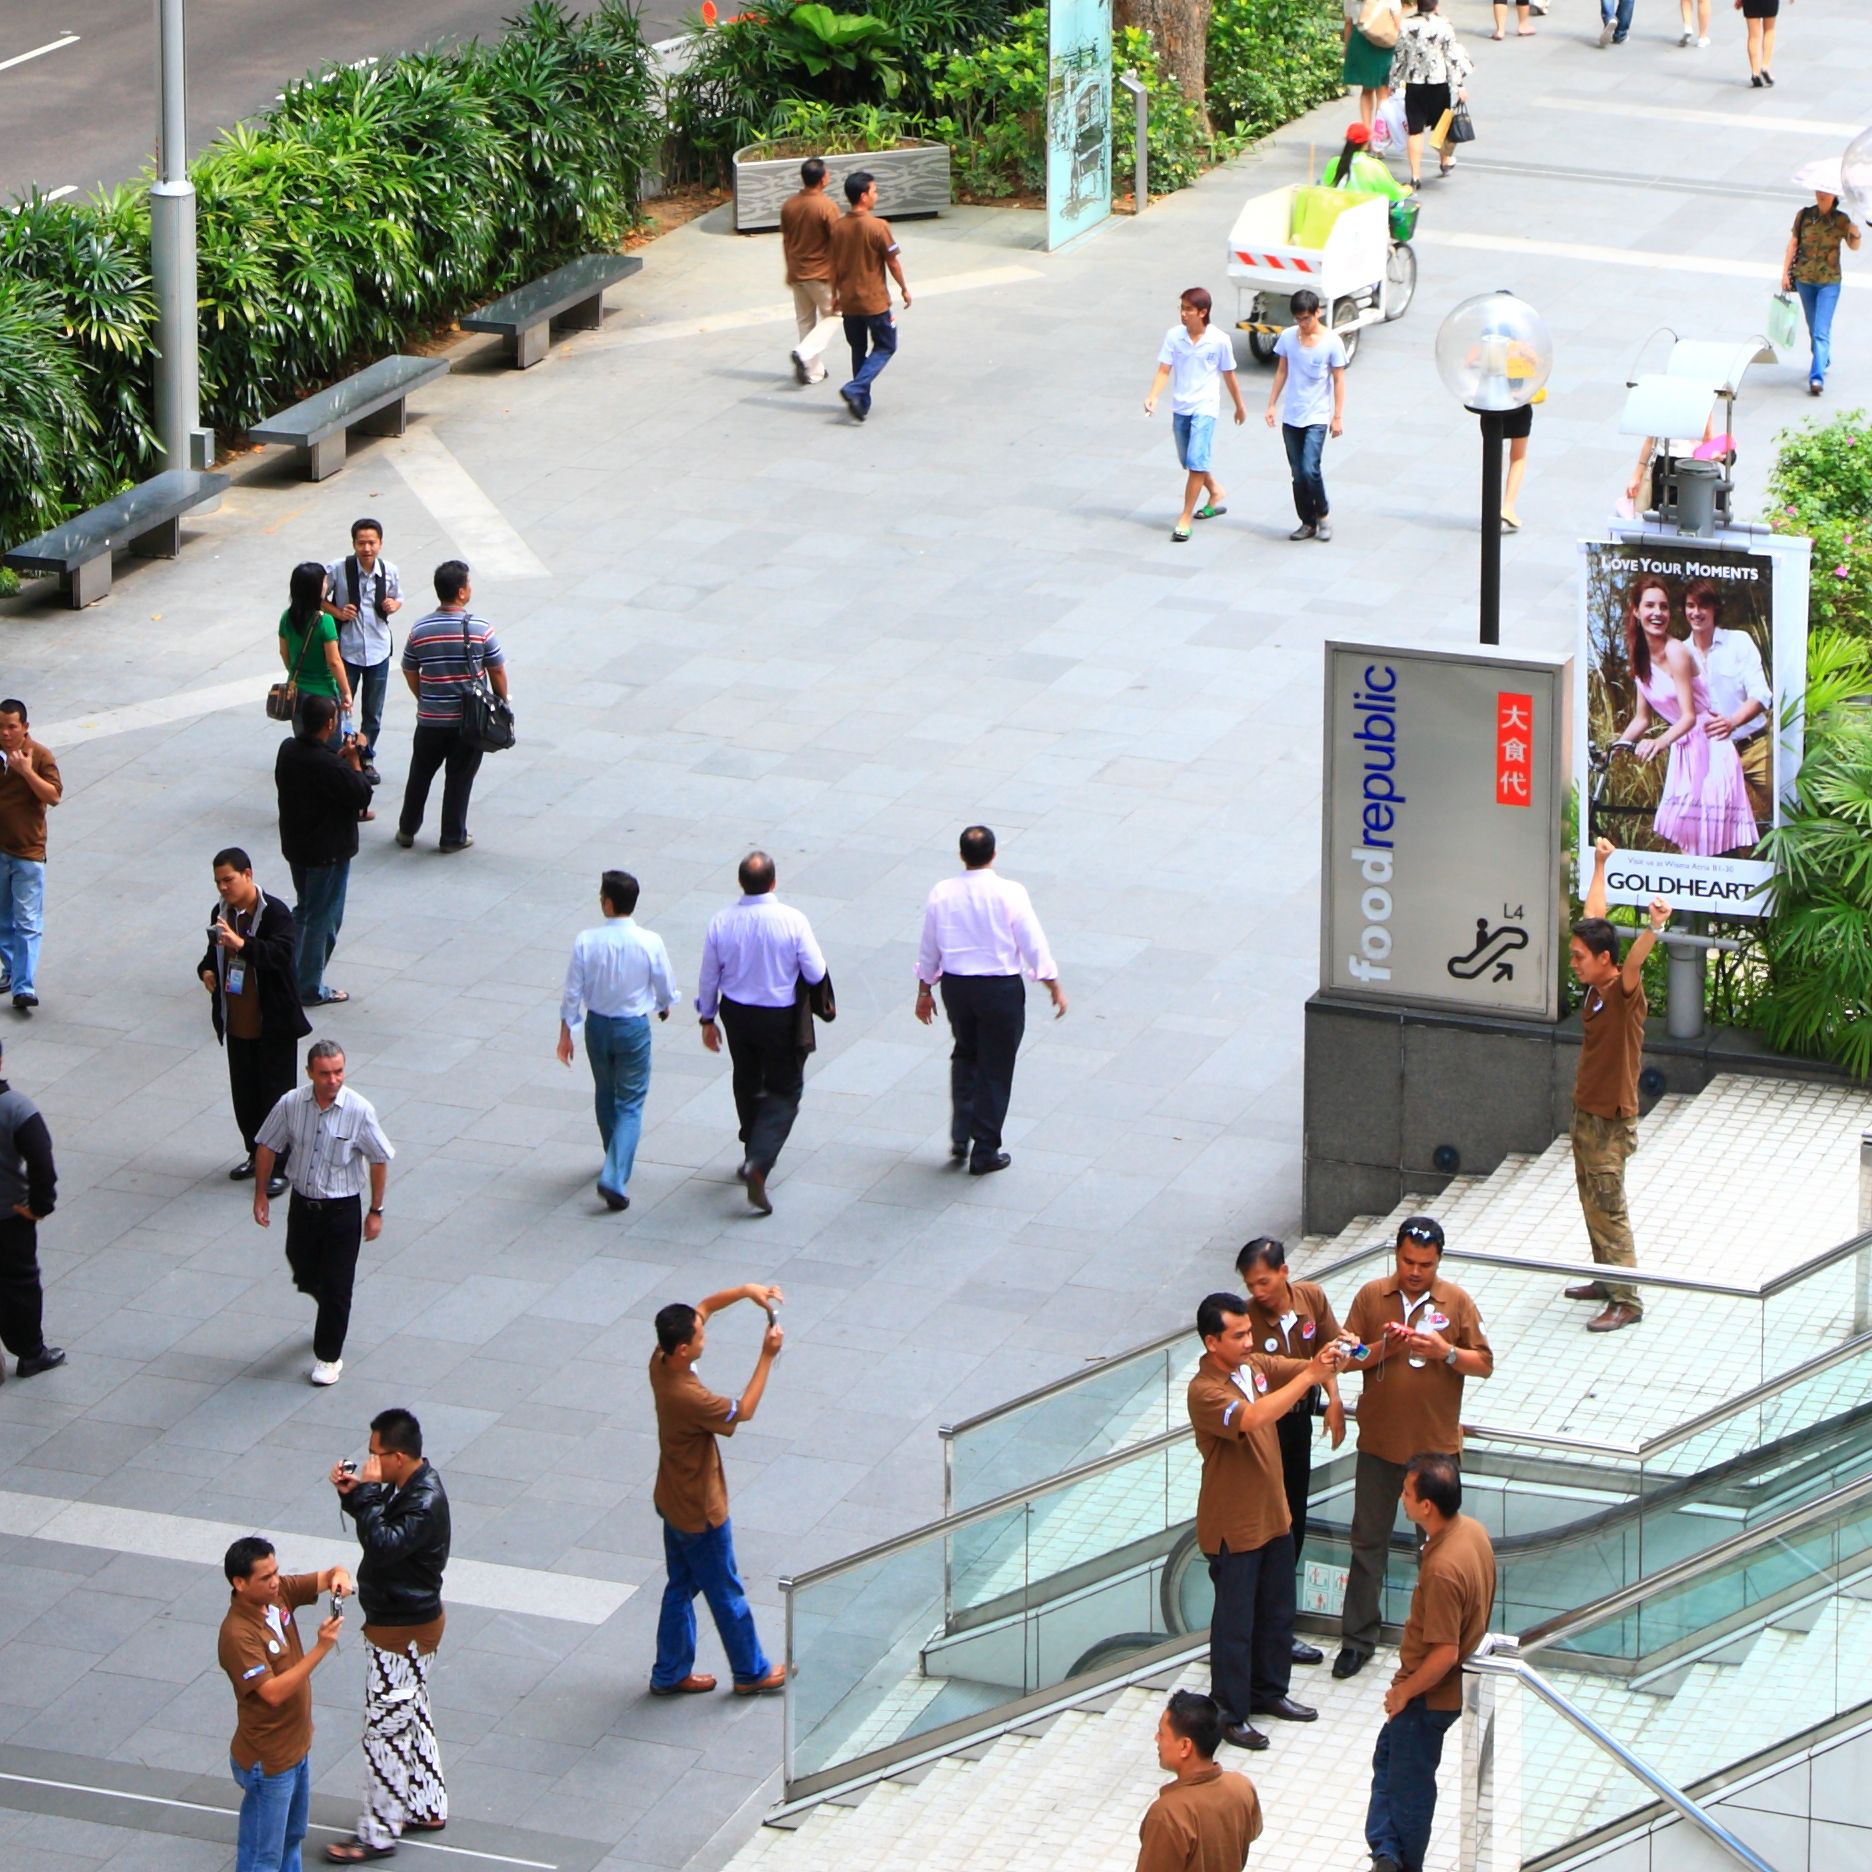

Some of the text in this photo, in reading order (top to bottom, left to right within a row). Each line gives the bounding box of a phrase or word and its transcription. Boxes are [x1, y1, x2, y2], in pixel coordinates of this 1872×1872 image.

[1601, 555, 1759, 581] LOVE YOUR MOMENTS
[1499, 704, 1529, 797] 大食代
[1628, 856, 1644, 866] Visit
[1646, 859, 1655, 867] us
[1665, 859, 1690, 870] Wisma
[1607, 872, 1755, 901] GOLDHEART
[1502, 902, 1525, 921] L4
